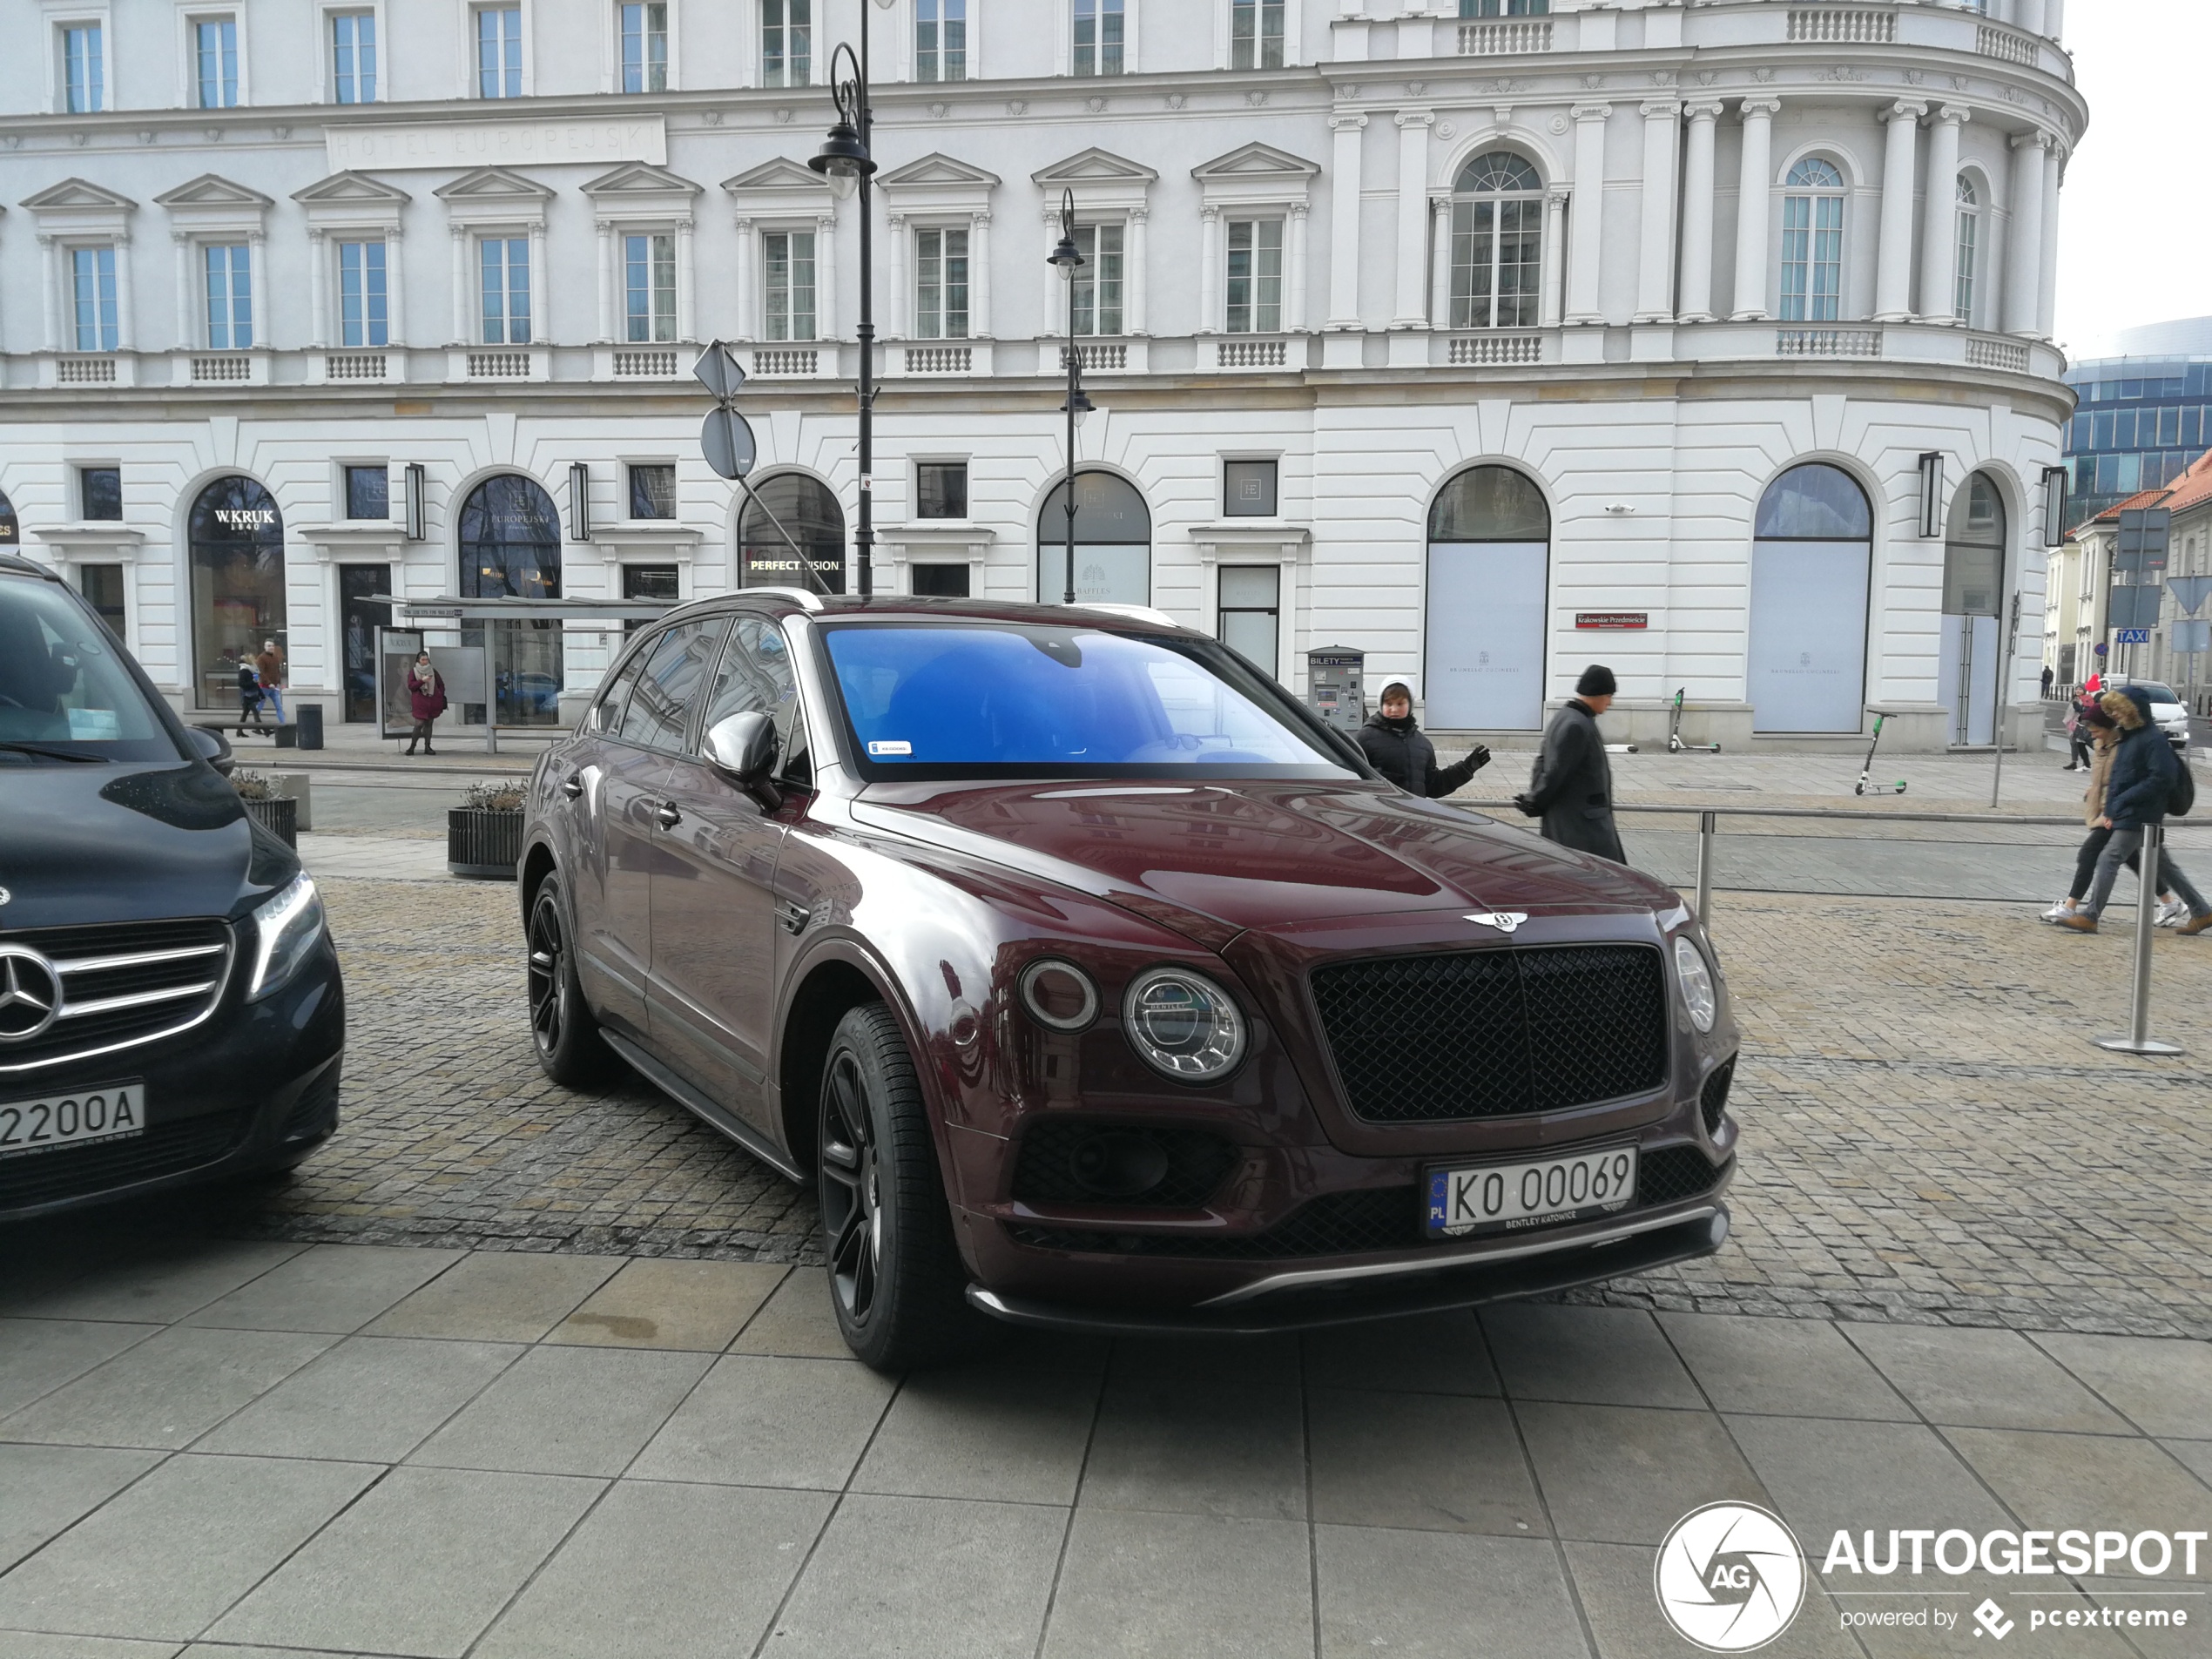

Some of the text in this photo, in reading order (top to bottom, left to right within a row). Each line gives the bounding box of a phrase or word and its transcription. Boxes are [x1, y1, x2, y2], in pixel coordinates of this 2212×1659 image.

[335, 125, 656, 158] HOTEL EUROPEJSKI
[214, 509, 275, 523] W.KRUK
[230, 523, 260, 531] 1840
[751, 560, 800, 570] PERFECT
[2118, 631, 2148, 642] TAXI
[1430, 1206, 1445, 1220] PL
[1506, 1211, 1577, 1230] BENTLEY KATOWICE
